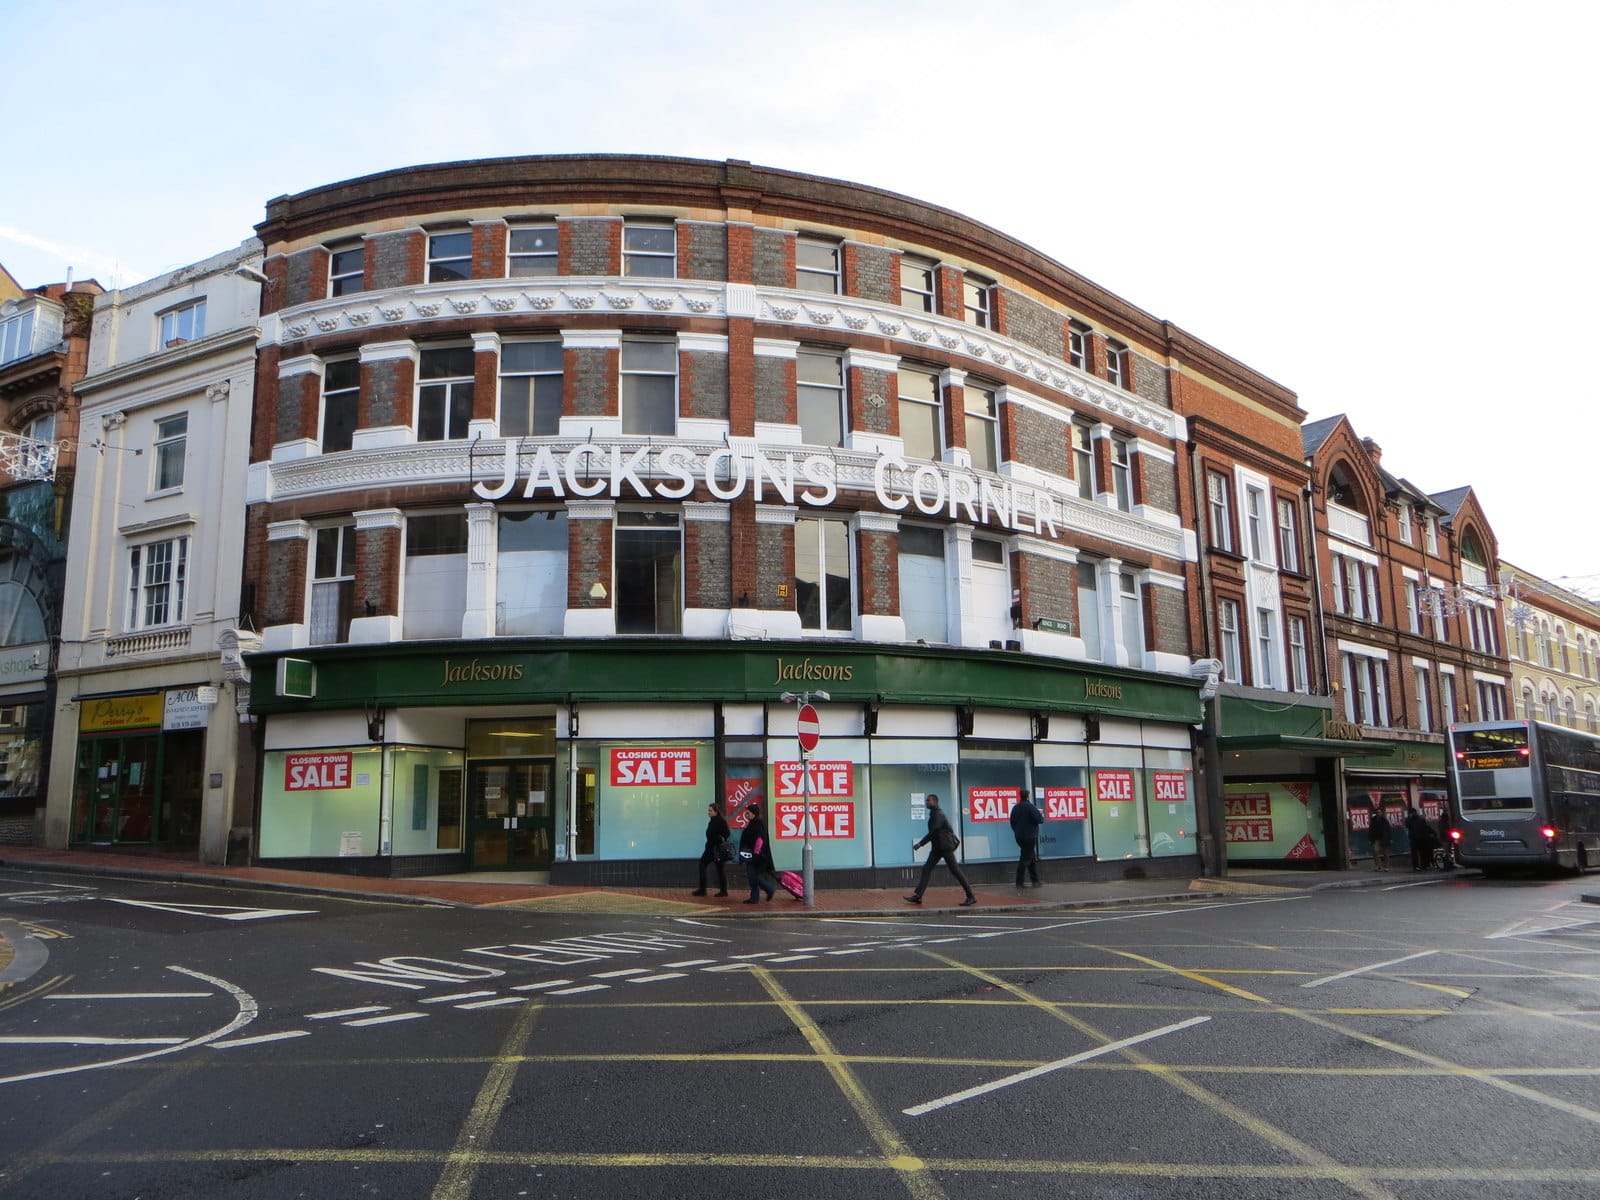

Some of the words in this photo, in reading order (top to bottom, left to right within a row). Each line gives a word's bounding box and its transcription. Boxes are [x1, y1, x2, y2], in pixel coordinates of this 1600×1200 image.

[472, 439, 838, 507] JACKSONS
[874, 453, 1058, 539] CORNER
[0, 656, 31, 675] shop
[441, 657, 524, 688] Jacksons
[773, 657, 853, 686] Jacksons
[168, 689, 200, 706] ACOR
[1084, 677, 1122, 700] Jacksons
[290, 757, 322, 765] CLOSING
[323, 755, 348, 763] DOWN
[616, 751, 658, 759] CLOSING
[660, 751, 691, 759] DOWN
[1466, 759, 1476, 768] 17
[289, 764, 348, 788] SALE
[616, 760, 691, 784] SALE
[819, 763, 847, 771] DOWN
[780, 772, 848, 795] SALE
[1099, 780, 1131, 799] SALE
[1157, 781, 1185, 799] SALE
[728, 781, 752, 807] Sale
[821, 805, 849, 813] DOWN
[1048, 797, 1085, 818] SALE
[1224, 799, 1268, 815] SALE
[781, 813, 849, 837] SALE
[1351, 814, 1370, 829] SALE
[1225, 825, 1270, 840] SALE
[1480, 829, 1505, 838] Reading
[1292, 840, 1309, 858] Sale
[311, 956, 507, 990] NO
[462, 930, 733, 966] ENTRY
